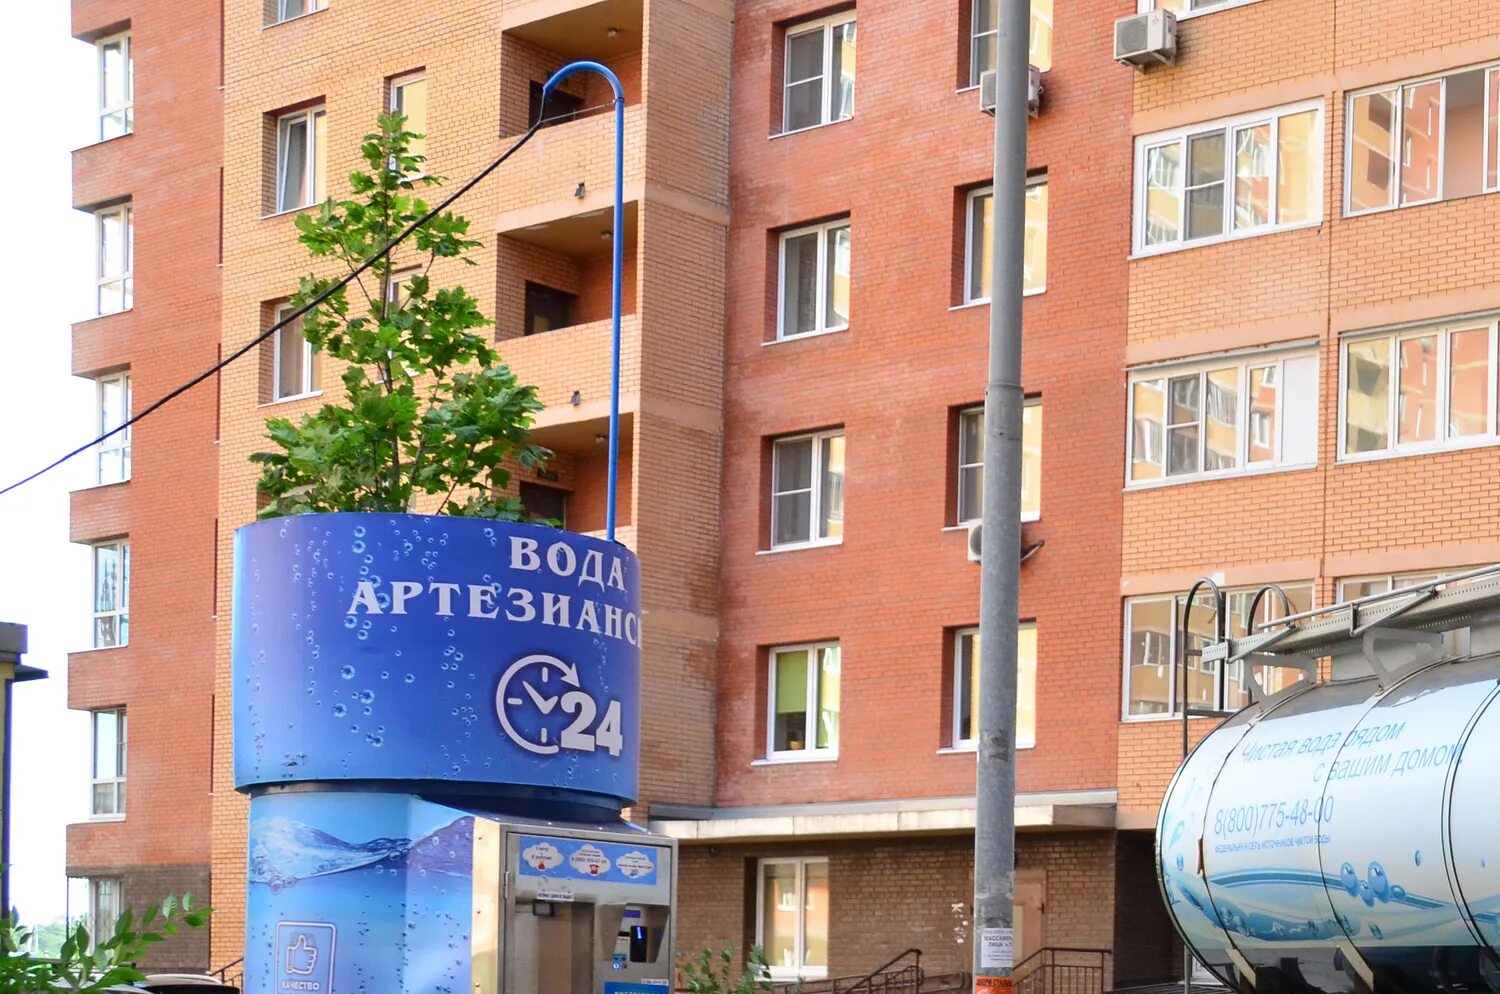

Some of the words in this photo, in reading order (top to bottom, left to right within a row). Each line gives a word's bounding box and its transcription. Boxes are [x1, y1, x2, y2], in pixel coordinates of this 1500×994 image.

[508, 536, 627, 592] ВОДА
[560, 690, 624, 757] 24
[1242, 738, 1296, 763] Чистая
[1297, 731, 1342, 755] вода
[1342, 721, 1407, 750] рядом
[1327, 752, 1391, 782] вашим
[1214, 796, 1334, 840] 8(800)775-48-00
[281, 980, 320, 991] КАЧЕСТВО
